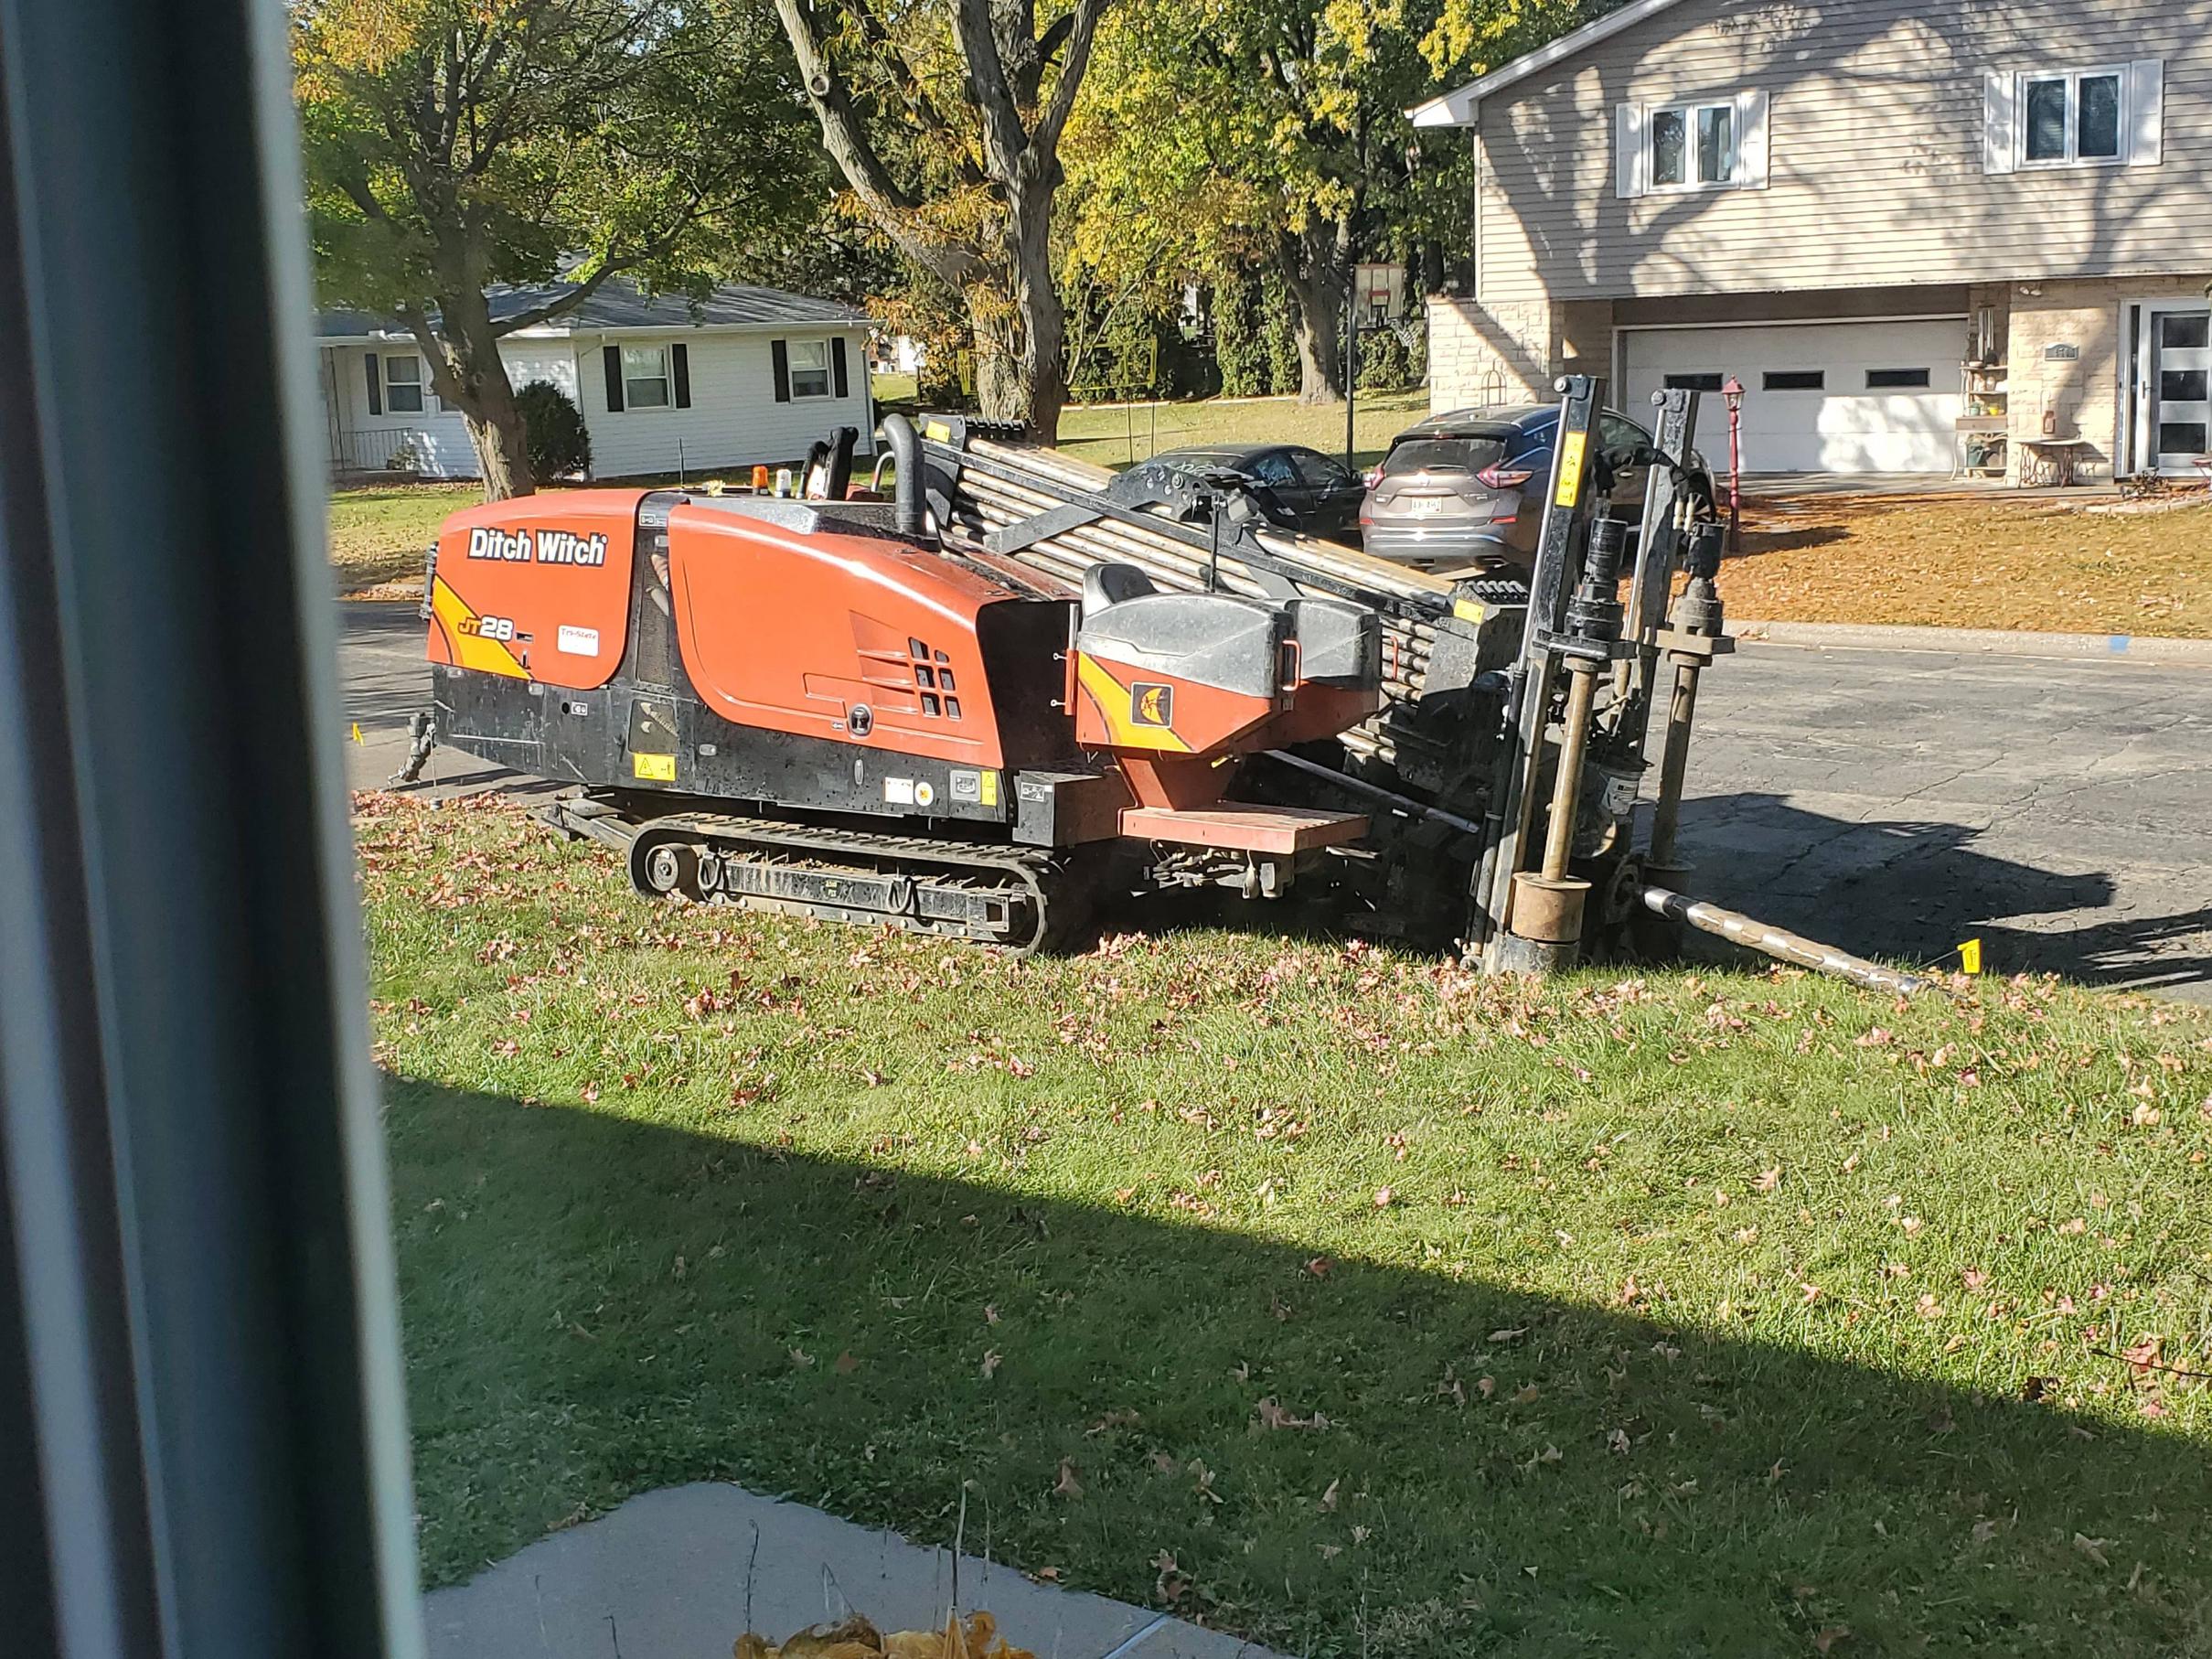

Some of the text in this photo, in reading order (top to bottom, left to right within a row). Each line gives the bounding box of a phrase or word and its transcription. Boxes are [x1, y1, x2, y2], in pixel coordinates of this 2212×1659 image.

[467, 527, 605, 566] Ditch Witch
[458, 615, 514, 641] JT28
